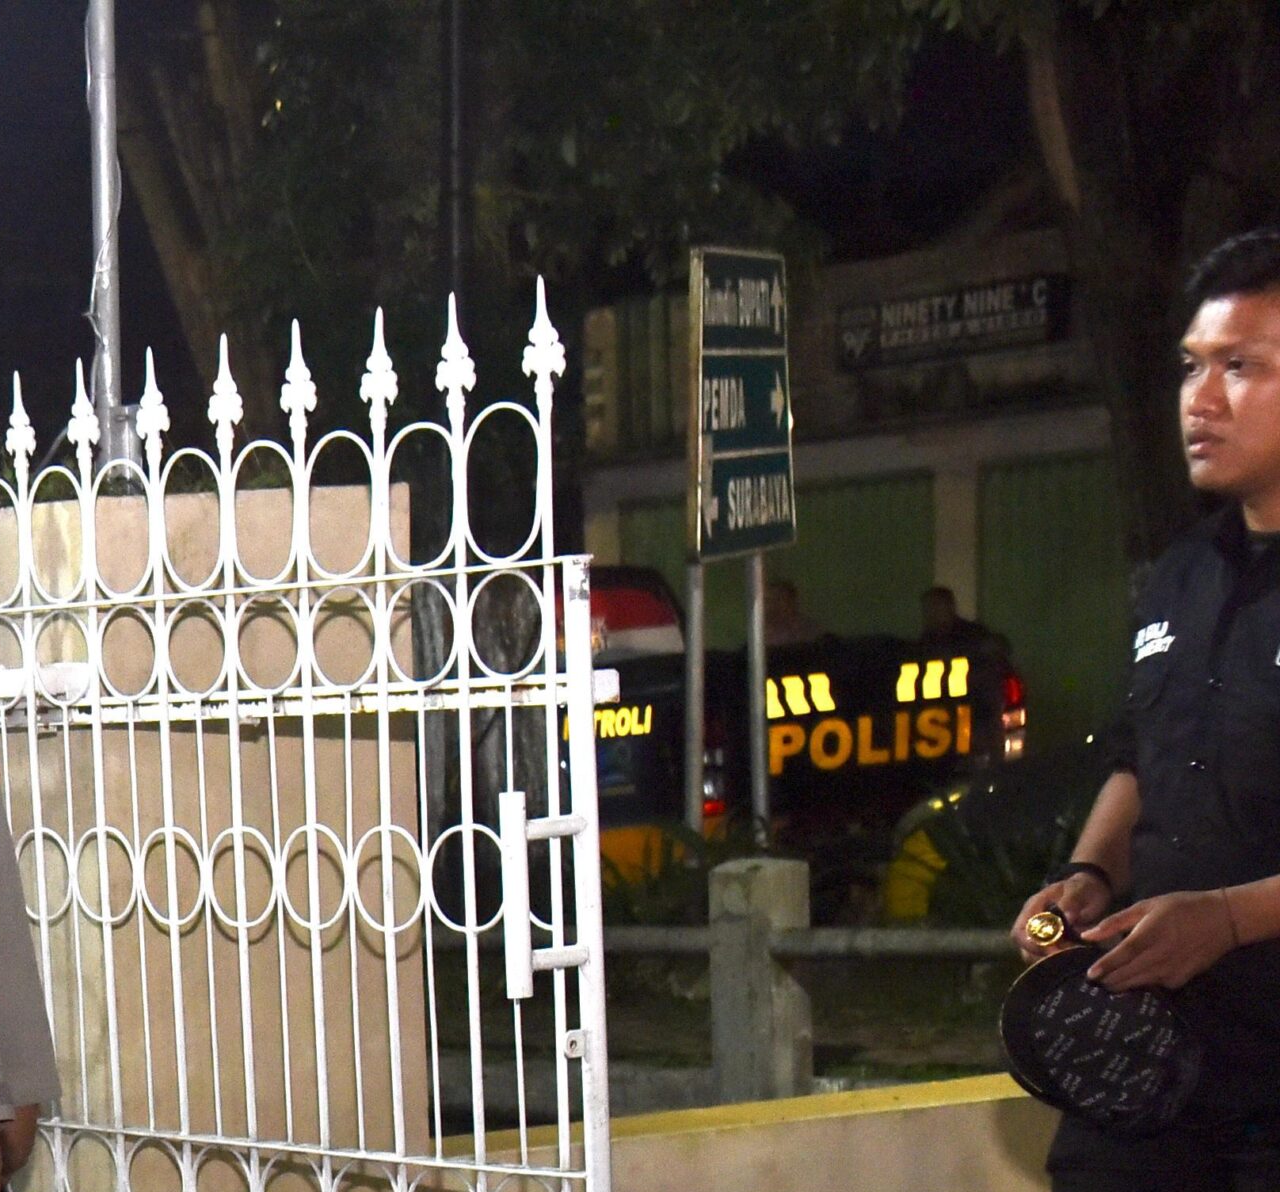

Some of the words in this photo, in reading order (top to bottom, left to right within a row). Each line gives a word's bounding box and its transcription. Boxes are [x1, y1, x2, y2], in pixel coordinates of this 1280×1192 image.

[704, 375, 746, 431] PEMDA
[727, 472, 791, 531] SURABAYA
[768, 704, 972, 777] POLISI
